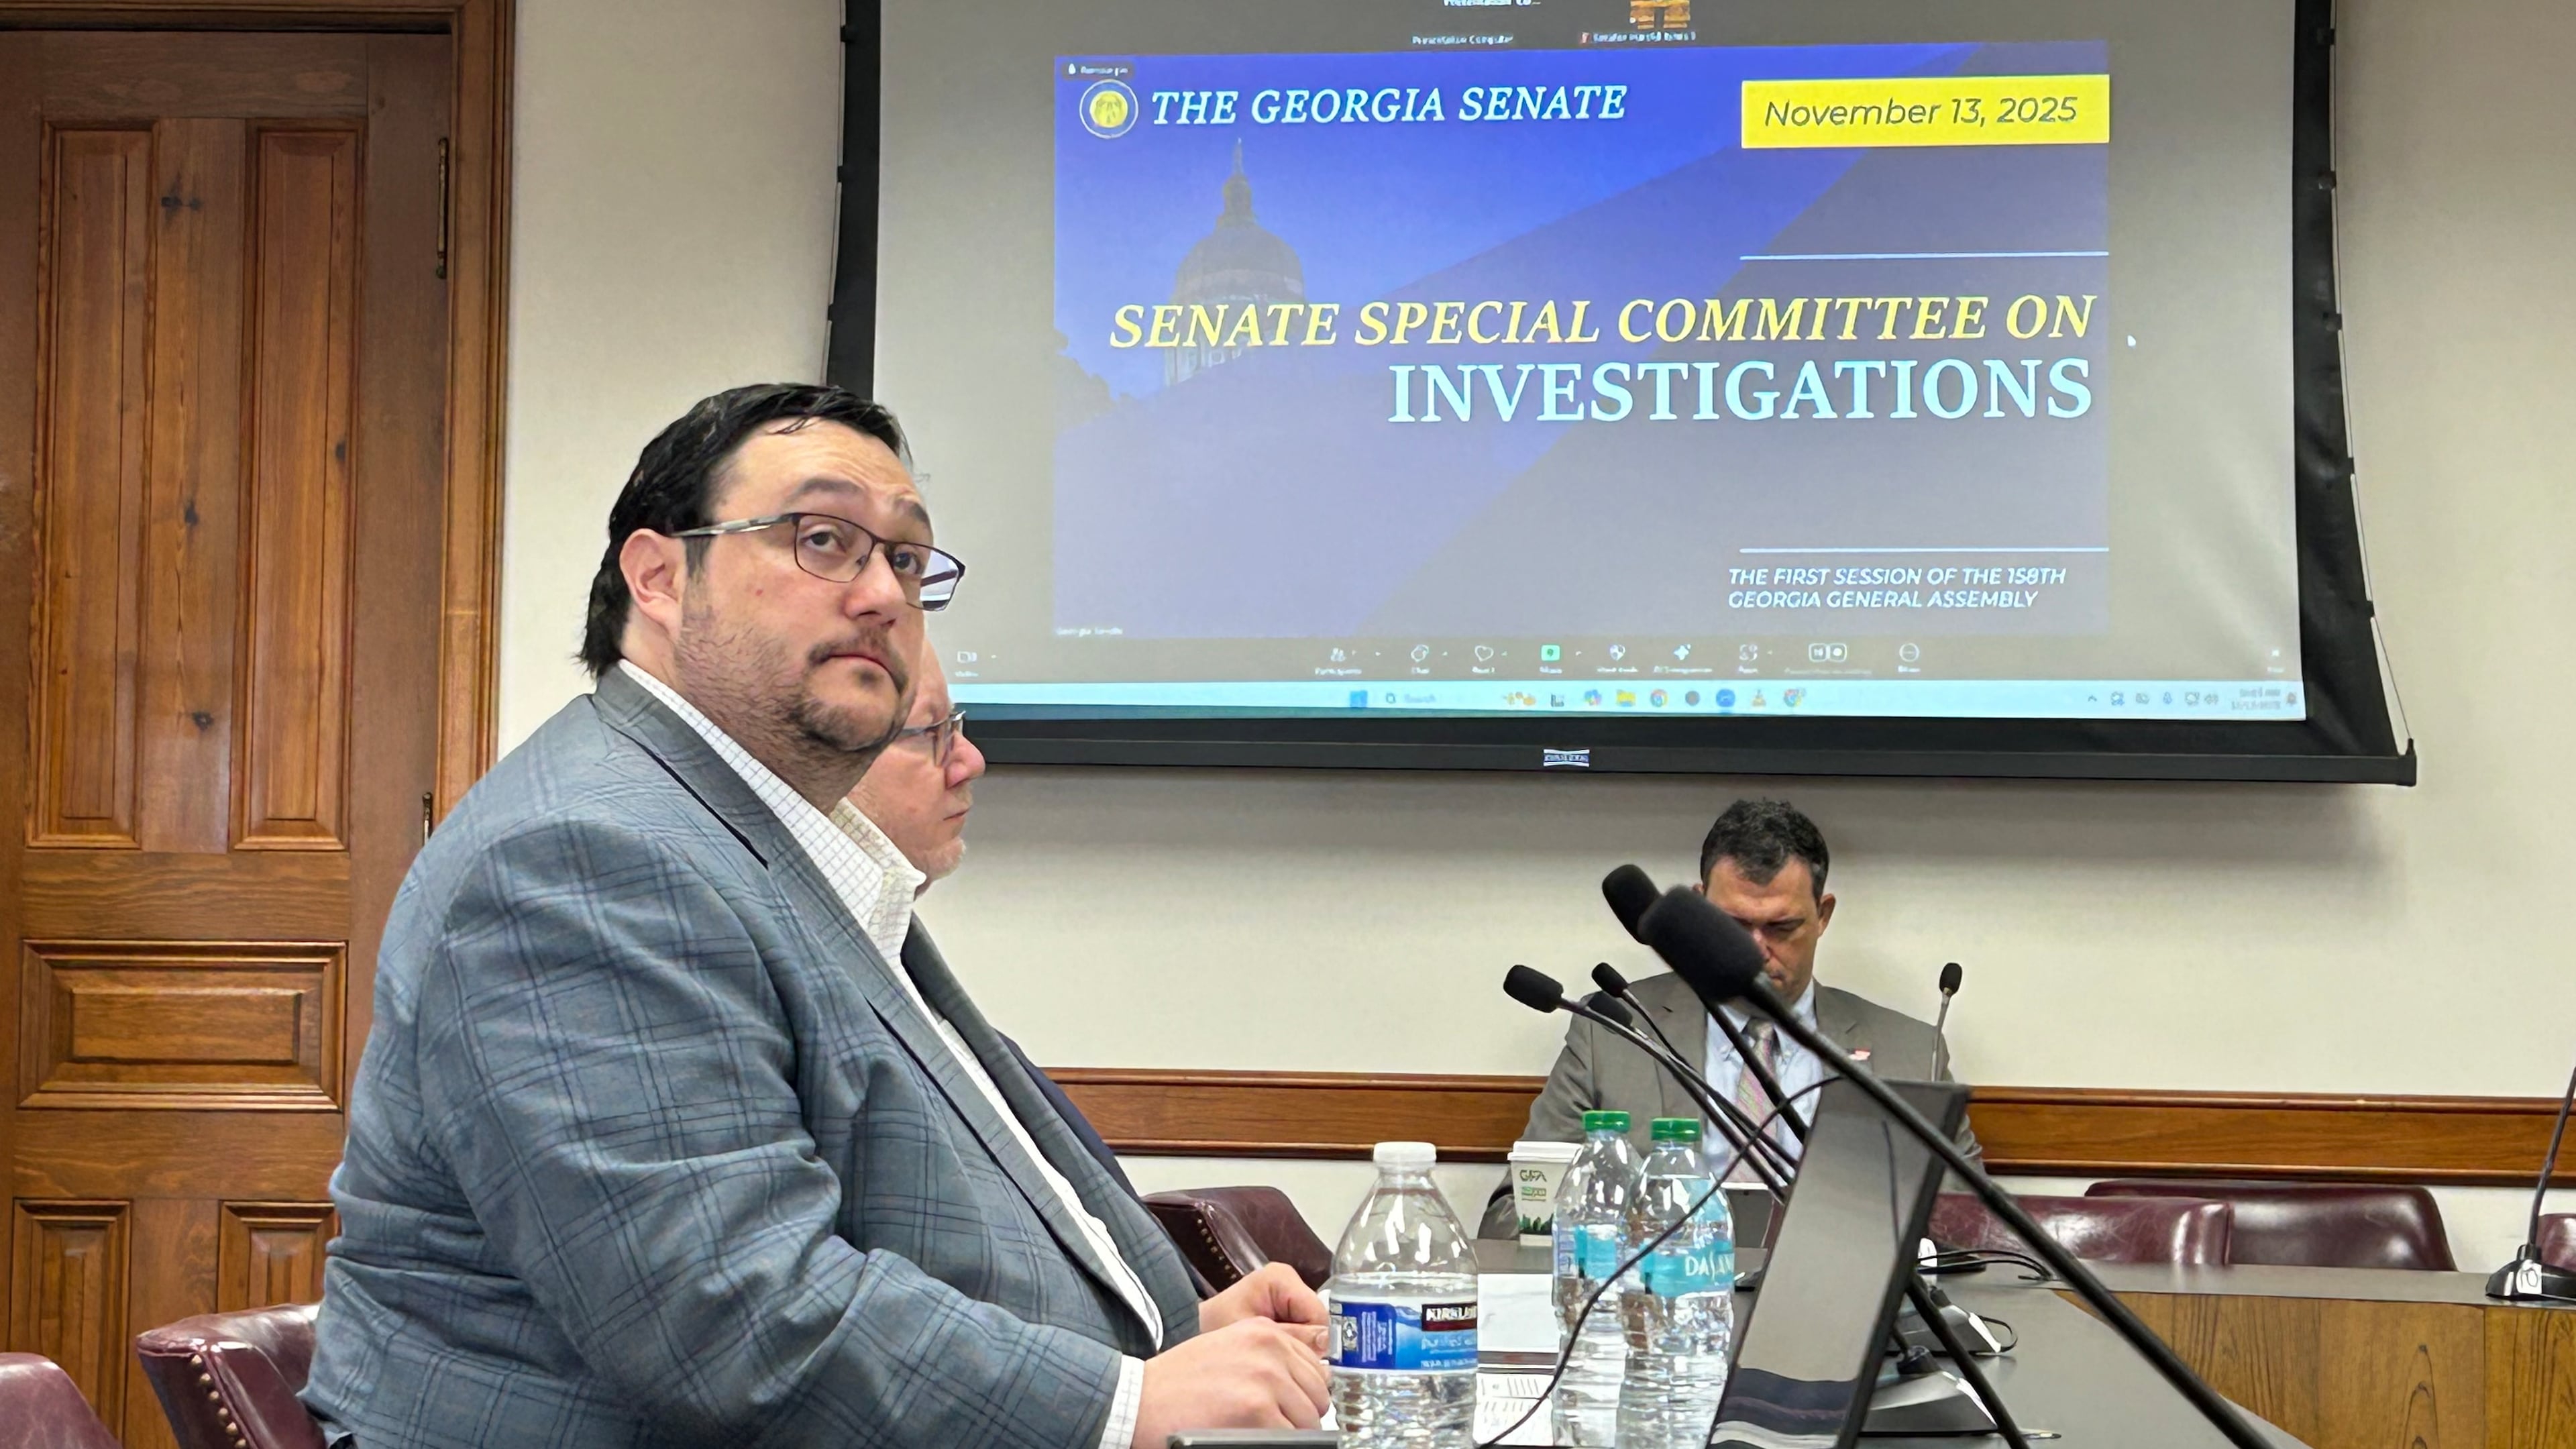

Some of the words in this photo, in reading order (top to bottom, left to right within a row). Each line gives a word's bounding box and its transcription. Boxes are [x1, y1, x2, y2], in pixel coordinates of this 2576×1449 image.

[1152, 90, 1238, 125] THE
[1250, 87, 1446, 125] GEORGIA
[1458, 85, 1629, 122] SENATE
[1764, 97, 1941, 127] November
[1951, 97, 1986, 128] 13,
[1996, 96, 2078, 124] 2025
[1109, 302, 1340, 348] SENATE
[1354, 299, 1601, 346] SPECIAL
[1617, 295, 1990, 343] COMMITTEE
[2005, 294, 2098, 341] ON
[1387, 357, 2093, 423] INVESTIGATIONS
[1728, 568, 1769, 586] THE
[1773, 568, 1830, 586] FIRST
[1833, 568, 1922, 585] SESSION
[1926, 568, 1957, 585] OF
[1962, 568, 2002, 585] THE
[2007, 567, 2068, 585] 158TH
[1727, 590, 1821, 608] GEORGIA
[1826, 590, 1923, 608] GENERAL
[1926, 590, 2039, 608] ASSEMBLY
